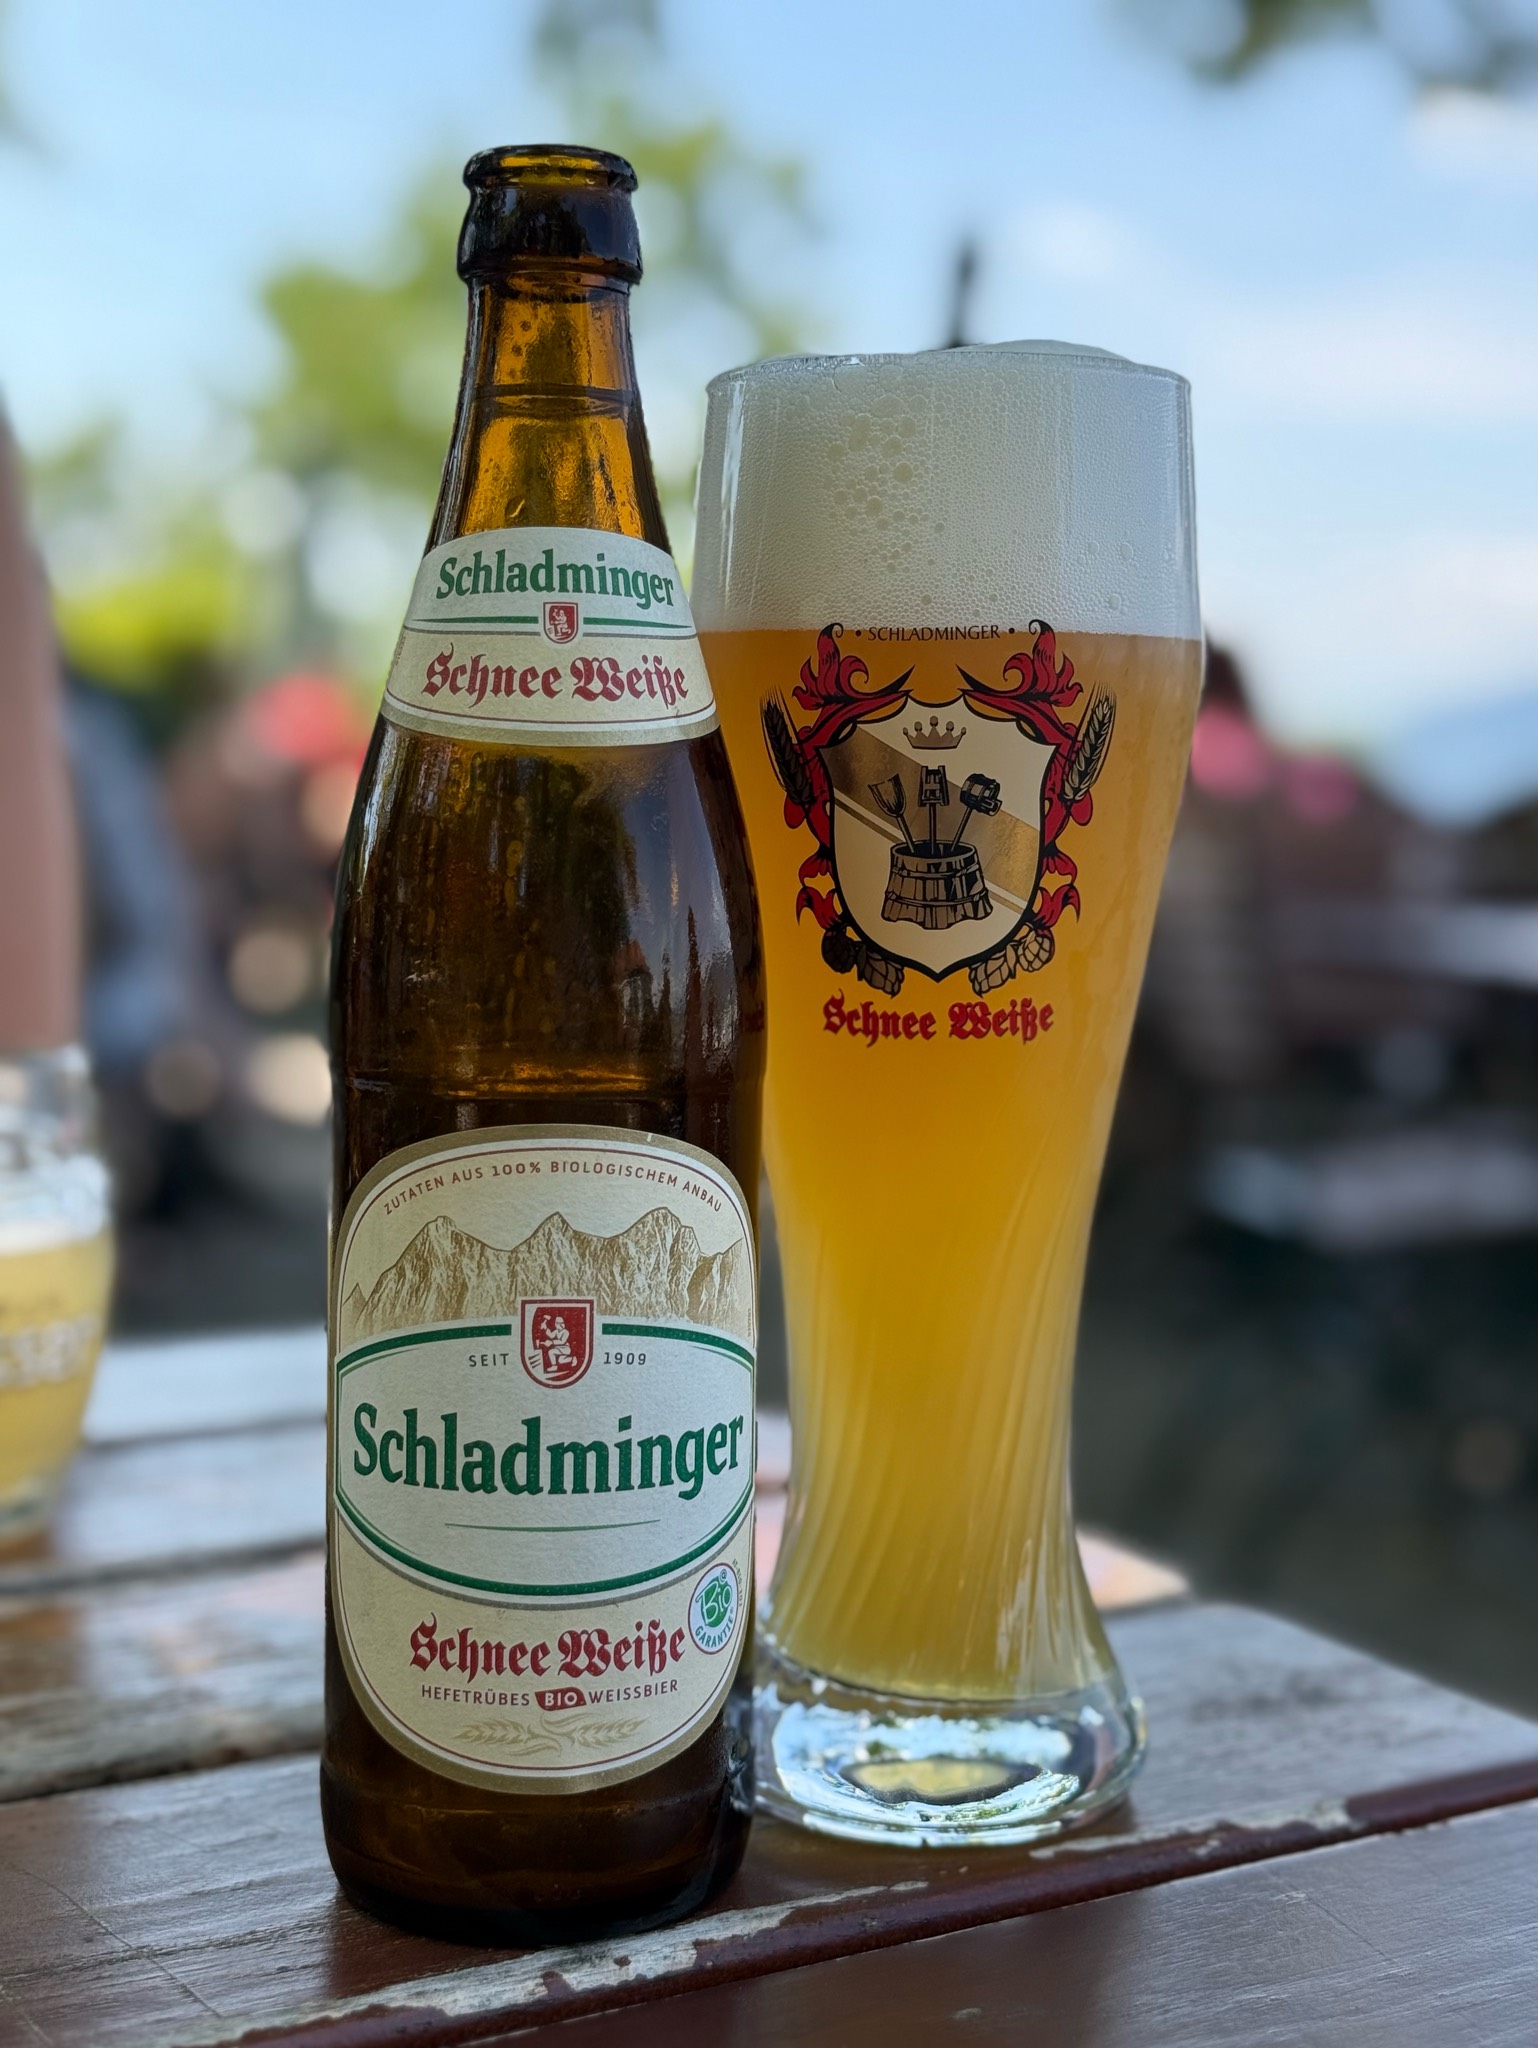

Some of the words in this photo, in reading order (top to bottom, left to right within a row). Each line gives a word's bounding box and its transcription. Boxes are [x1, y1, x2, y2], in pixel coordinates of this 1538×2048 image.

[435, 548, 674, 610] Schladminger
[867, 624, 1001, 642] SCHLADMINGER
[421, 642, 563, 708] Schnee
[569, 655, 689, 709] Weiße
[823, 988, 937, 1048] Schnee
[948, 997, 1054, 1045] Weiße
[383, 1175, 445, 1216] ZUTATEN
[451, 1167, 484, 1184] AUS
[492, 1161, 541, 1177] 100%
[550, 1161, 678, 1188] BIOLOGISCHEM
[682, 1180, 722, 1213] ANBAU
[468, 1352, 510, 1367] SEIT
[603, 1352, 647, 1366] 1909
[353, 1402, 744, 1501] Schladminger
[409, 1612, 551, 1684] Schnee
[557, 1619, 686, 1678] Weiße
[421, 1684, 530, 1706] HEFETRÜBES
[544, 1691, 578, 1707] BIO
[588, 1679, 679, 1704] WEISSBIER
